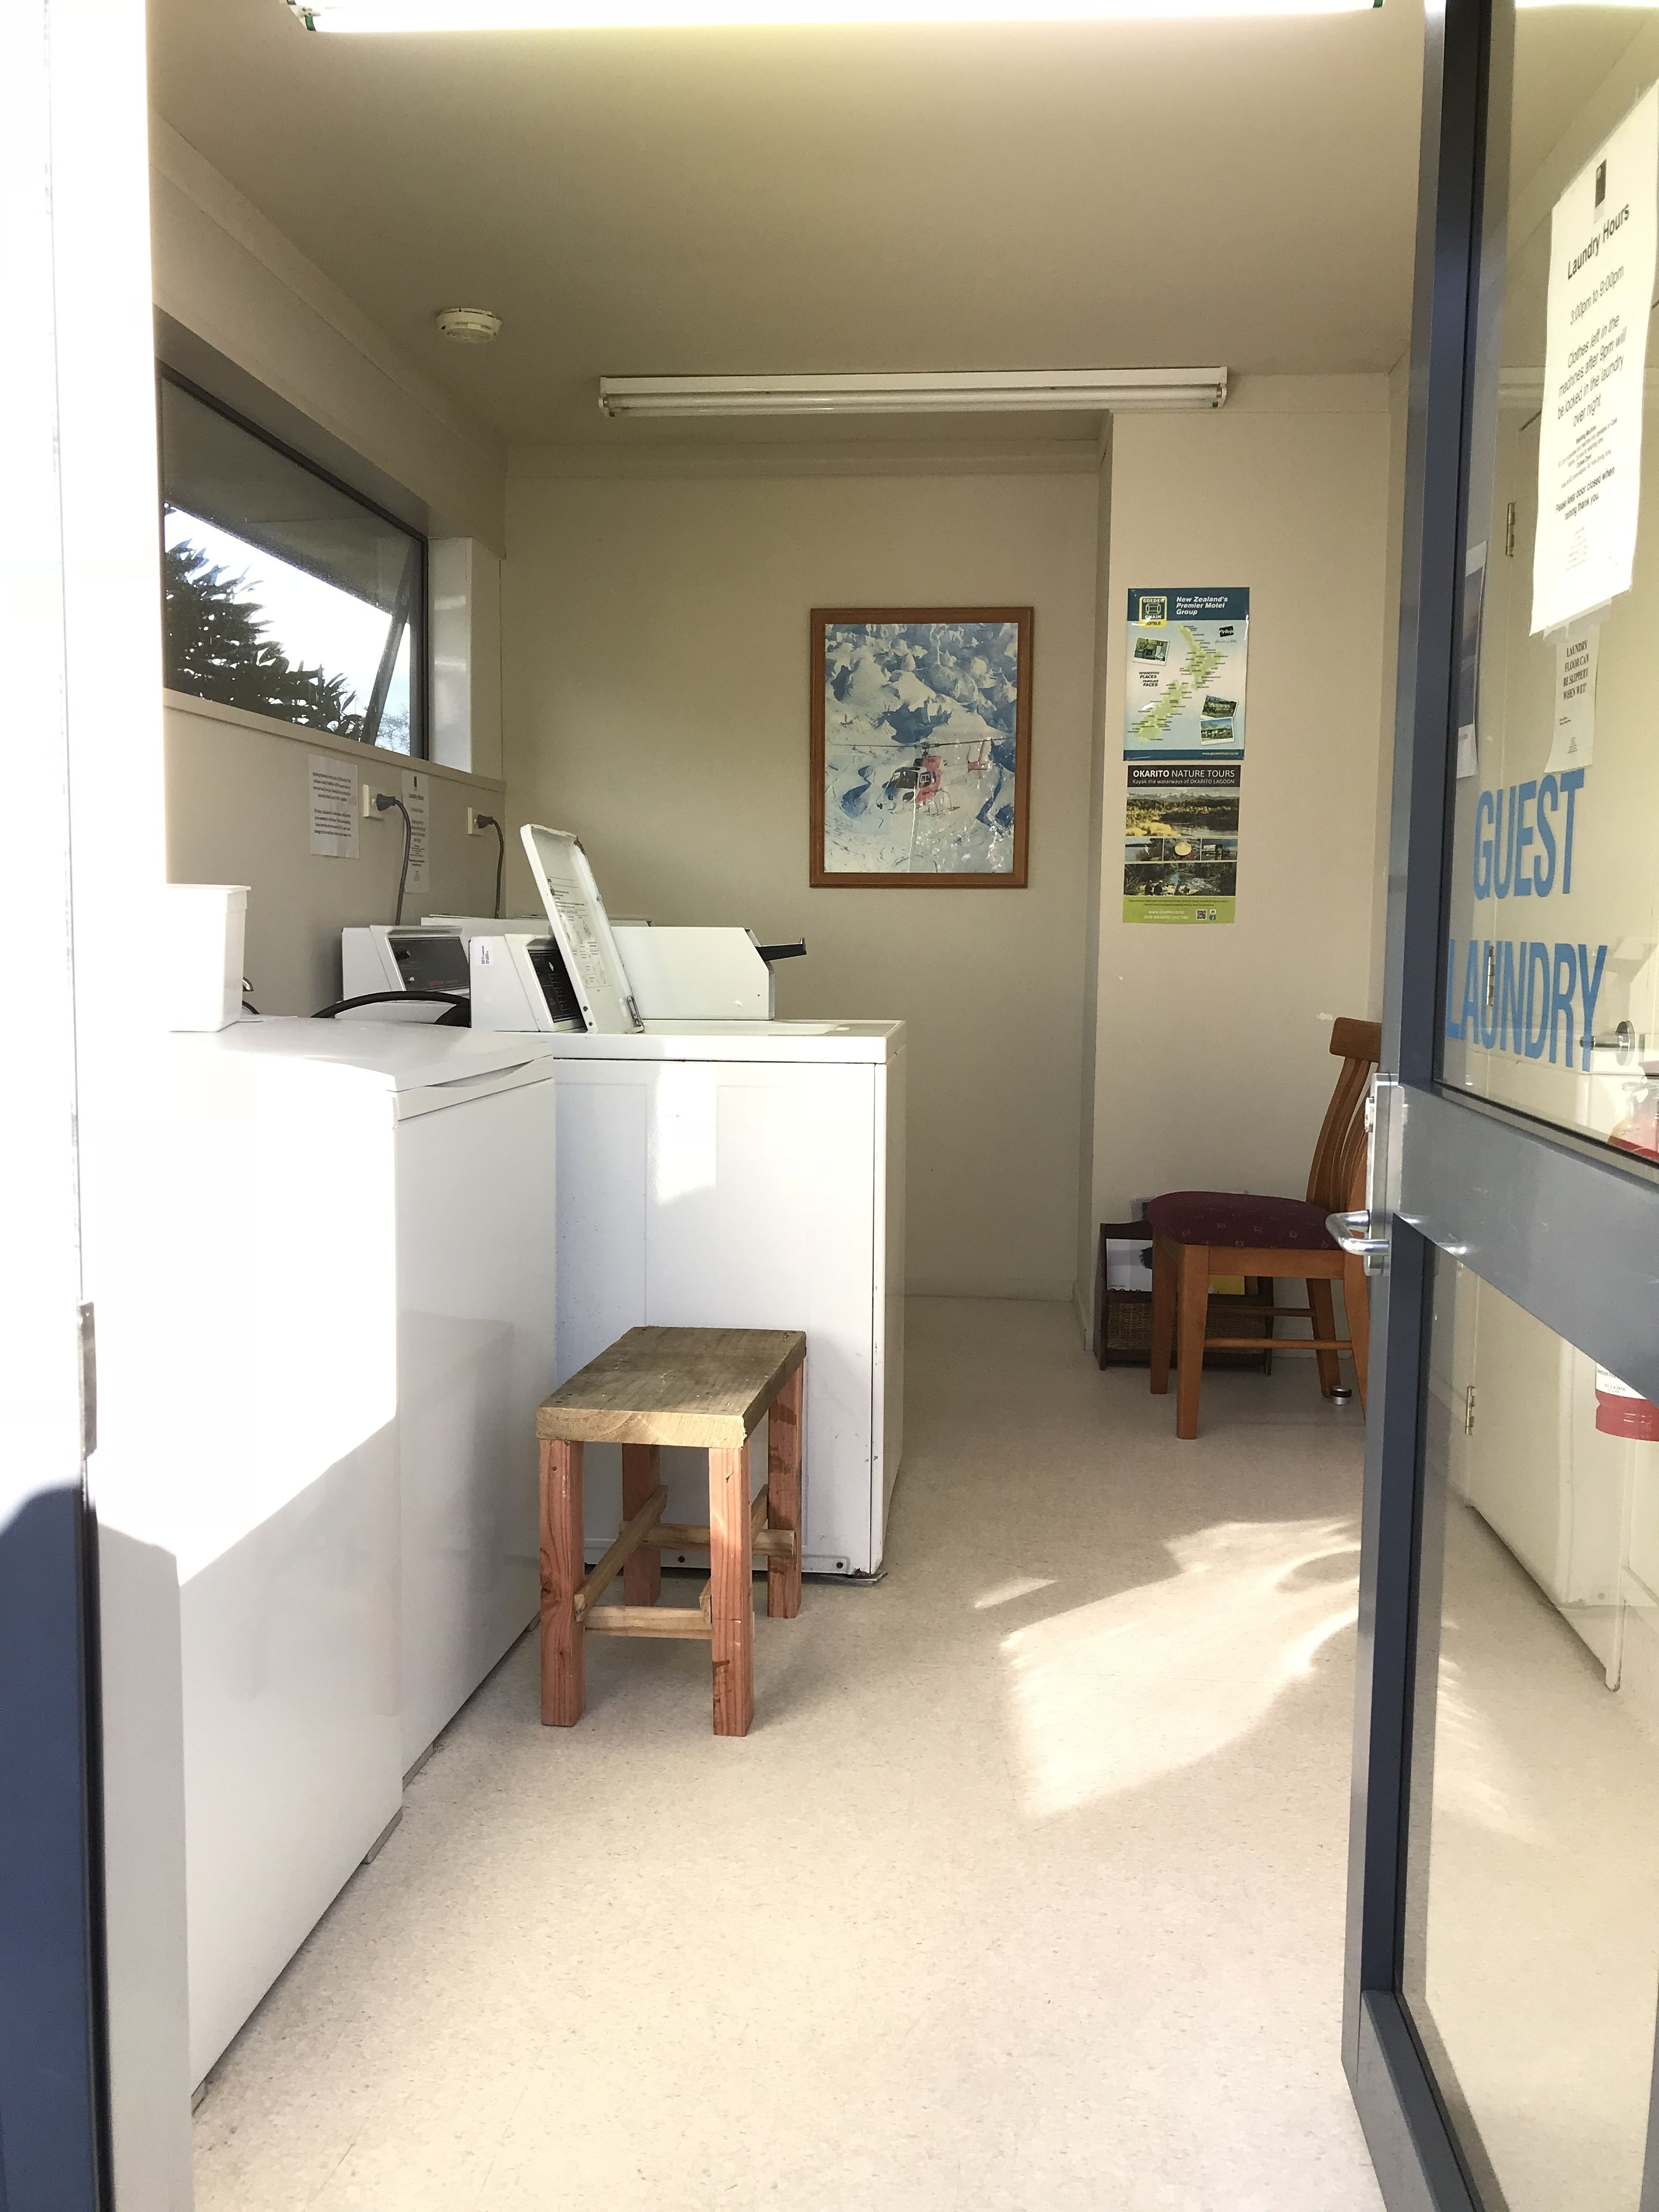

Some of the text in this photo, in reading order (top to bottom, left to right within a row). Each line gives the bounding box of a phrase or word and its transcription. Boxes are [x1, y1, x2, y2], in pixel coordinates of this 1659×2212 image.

[1567, 204, 1630, 280] Laundry Hours
[1593, 289, 1599, 304] to
[1600, 266, 1624, 296] 9:00pm
[1559, 326, 1627, 398] machines after 9pm will
[1568, 315, 1619, 368] Clothes left in the
[1558, 354, 1624, 420] be locked in the laundry
[1573, 392, 1601, 427] over night
[1556, 500, 1566, 513] Please
[1567, 493, 1575, 505] keep
[1576, 486, 1586, 498] door
[1587, 473, 1601, 491] closed
[1602, 467, 1615, 480] when
[1578, 498, 1589, 511] thank
[1565, 653, 1589, 672] FLOOR CAN
[1567, 640, 1588, 657] LAUNDRY
[1563, 668, 1589, 687] BE SLIPPERY
[1563, 687, 1576, 700] WHEN
[1473, 768, 1585, 900] GUEST
[1445, 938, 1608, 1072] LAUNDRY
